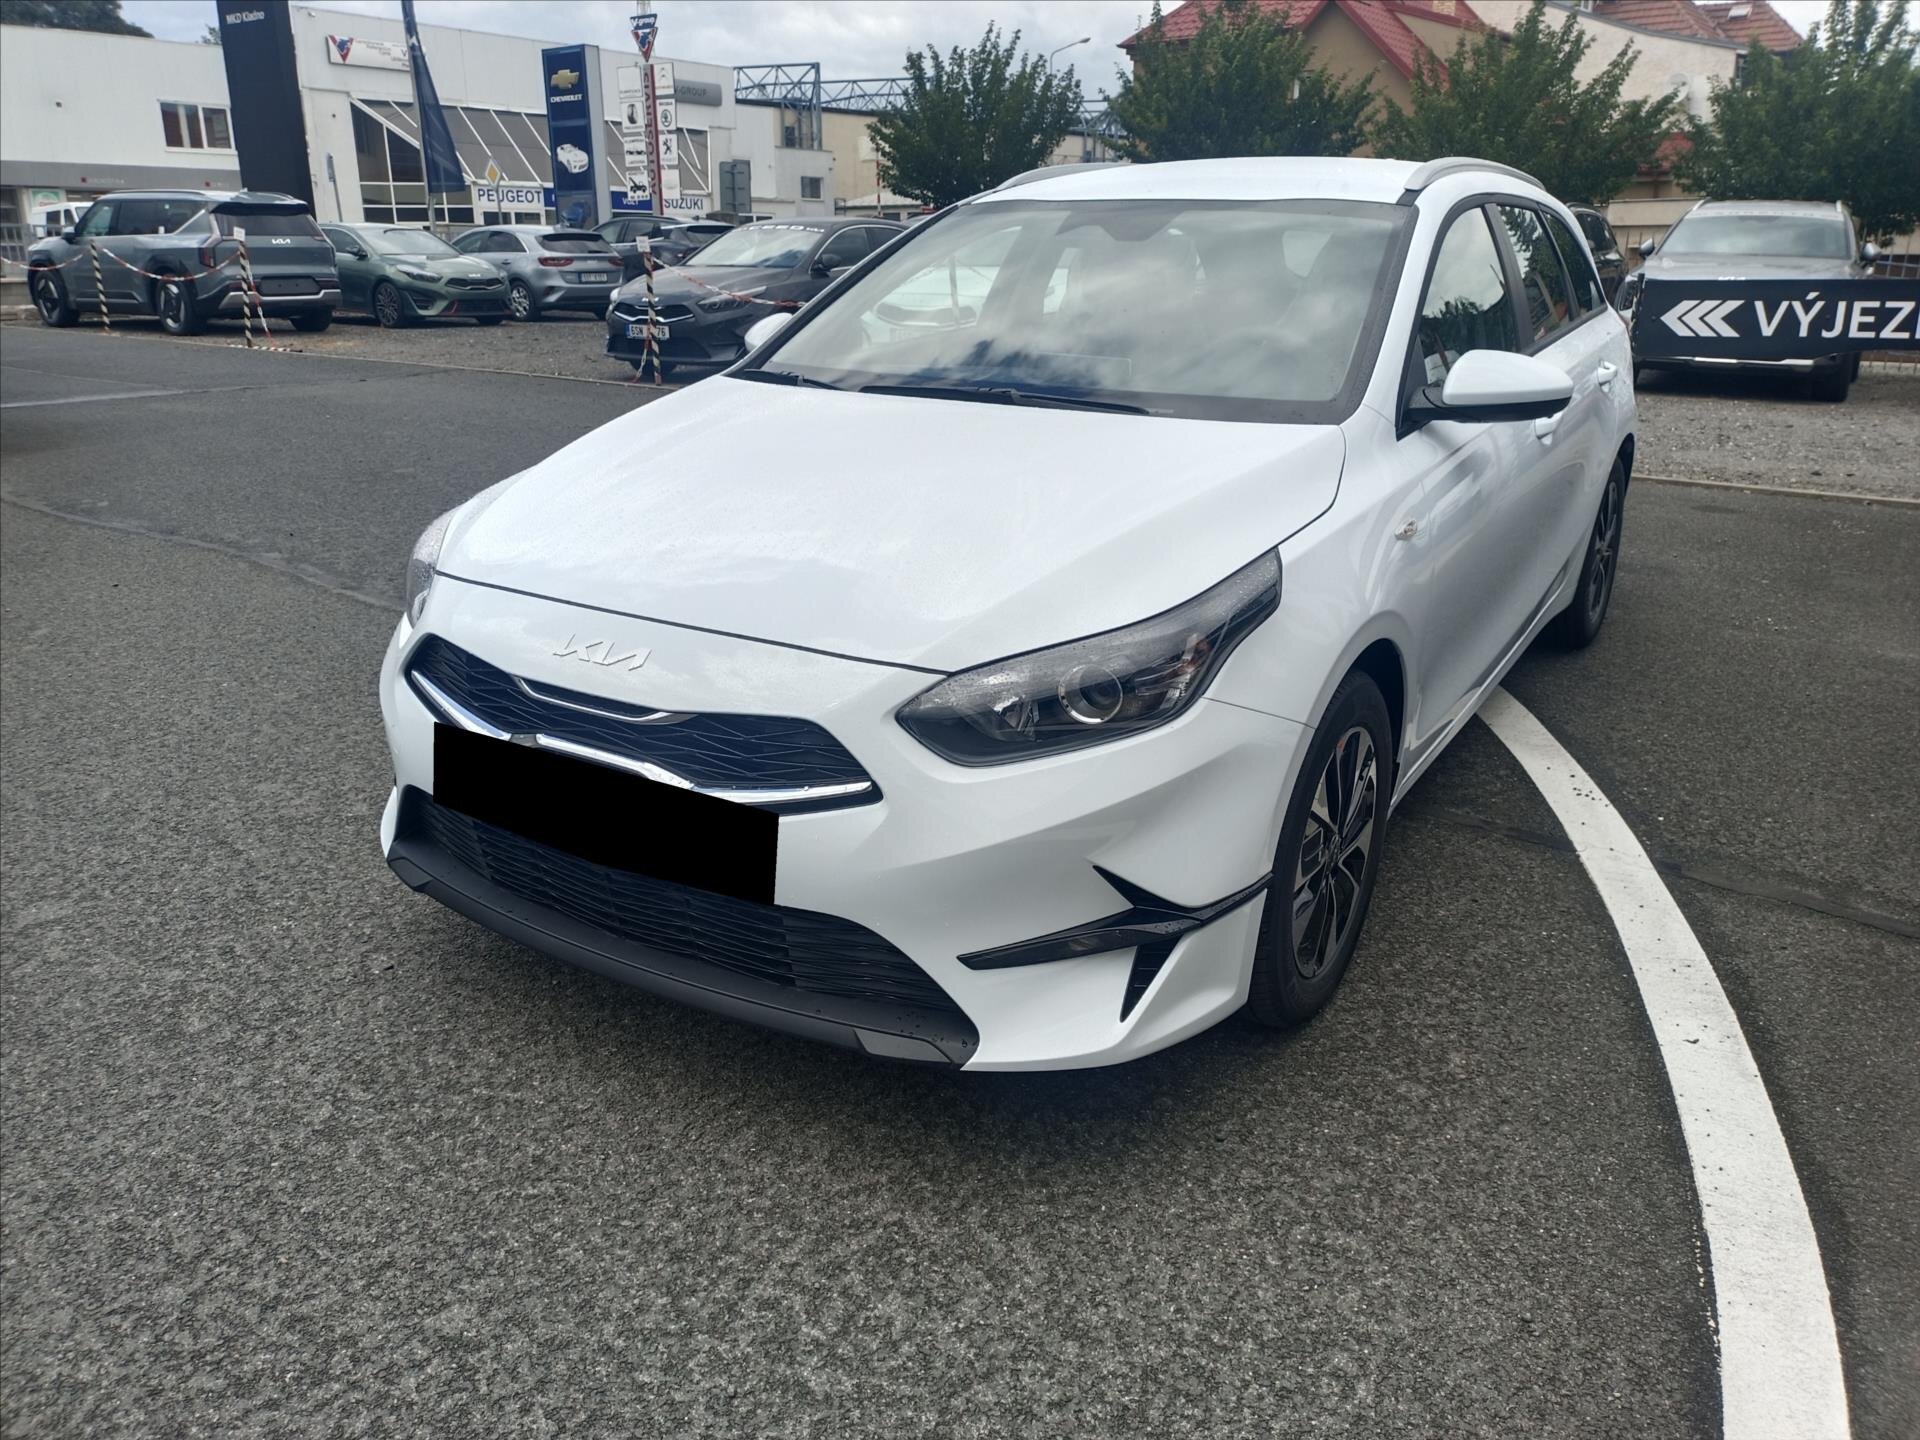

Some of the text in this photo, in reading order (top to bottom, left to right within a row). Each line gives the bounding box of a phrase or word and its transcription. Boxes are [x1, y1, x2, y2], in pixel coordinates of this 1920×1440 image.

[478, 188, 542, 204] PEUGEOT
[664, 198, 704, 210] SUZUKI
[1754, 292, 1920, 340] VÝJEZ
[552, 632, 653, 672] KIA
